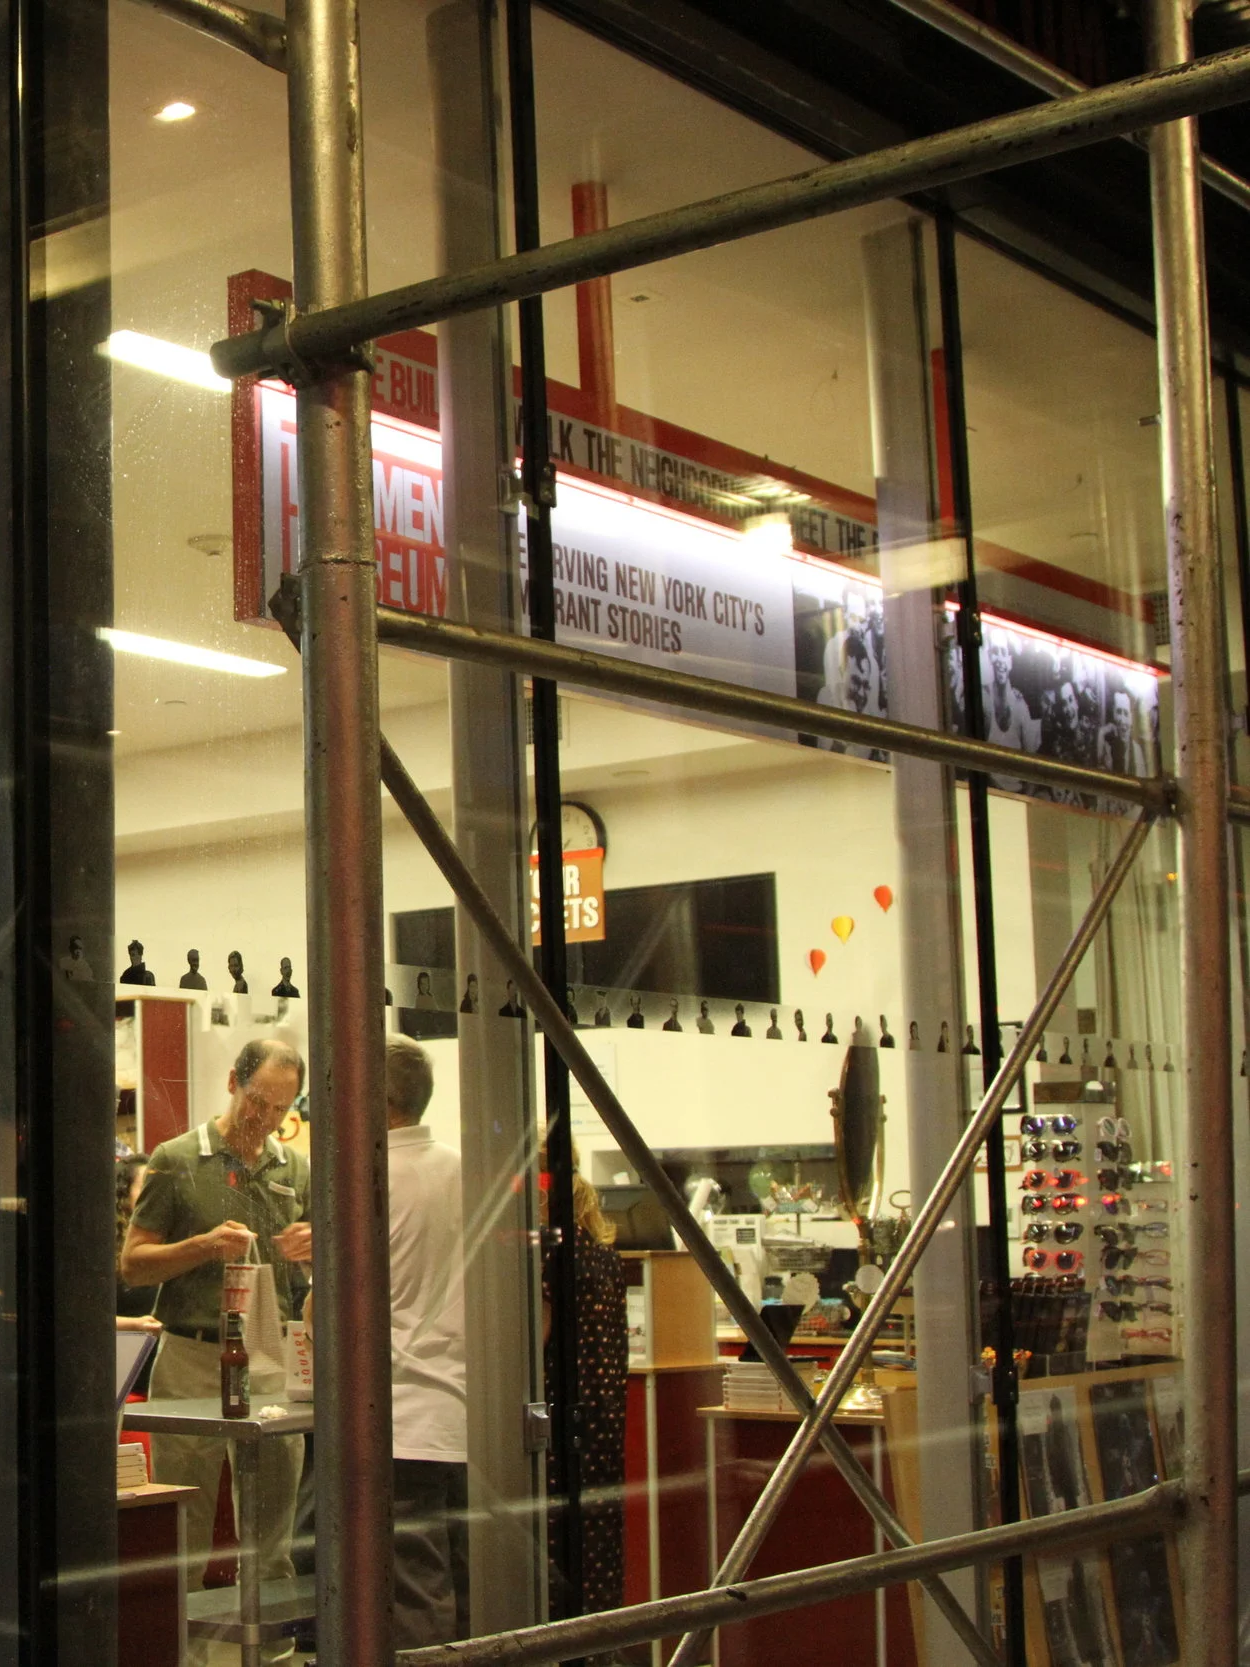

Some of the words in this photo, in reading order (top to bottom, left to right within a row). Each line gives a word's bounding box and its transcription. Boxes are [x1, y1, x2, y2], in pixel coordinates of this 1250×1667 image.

[583, 427, 623, 480] THE
[615, 561, 656, 607] NEW
[661, 575, 708, 631] YORK
[712, 590, 766, 637] CITY'S
[607, 602, 683, 655] STORIES
